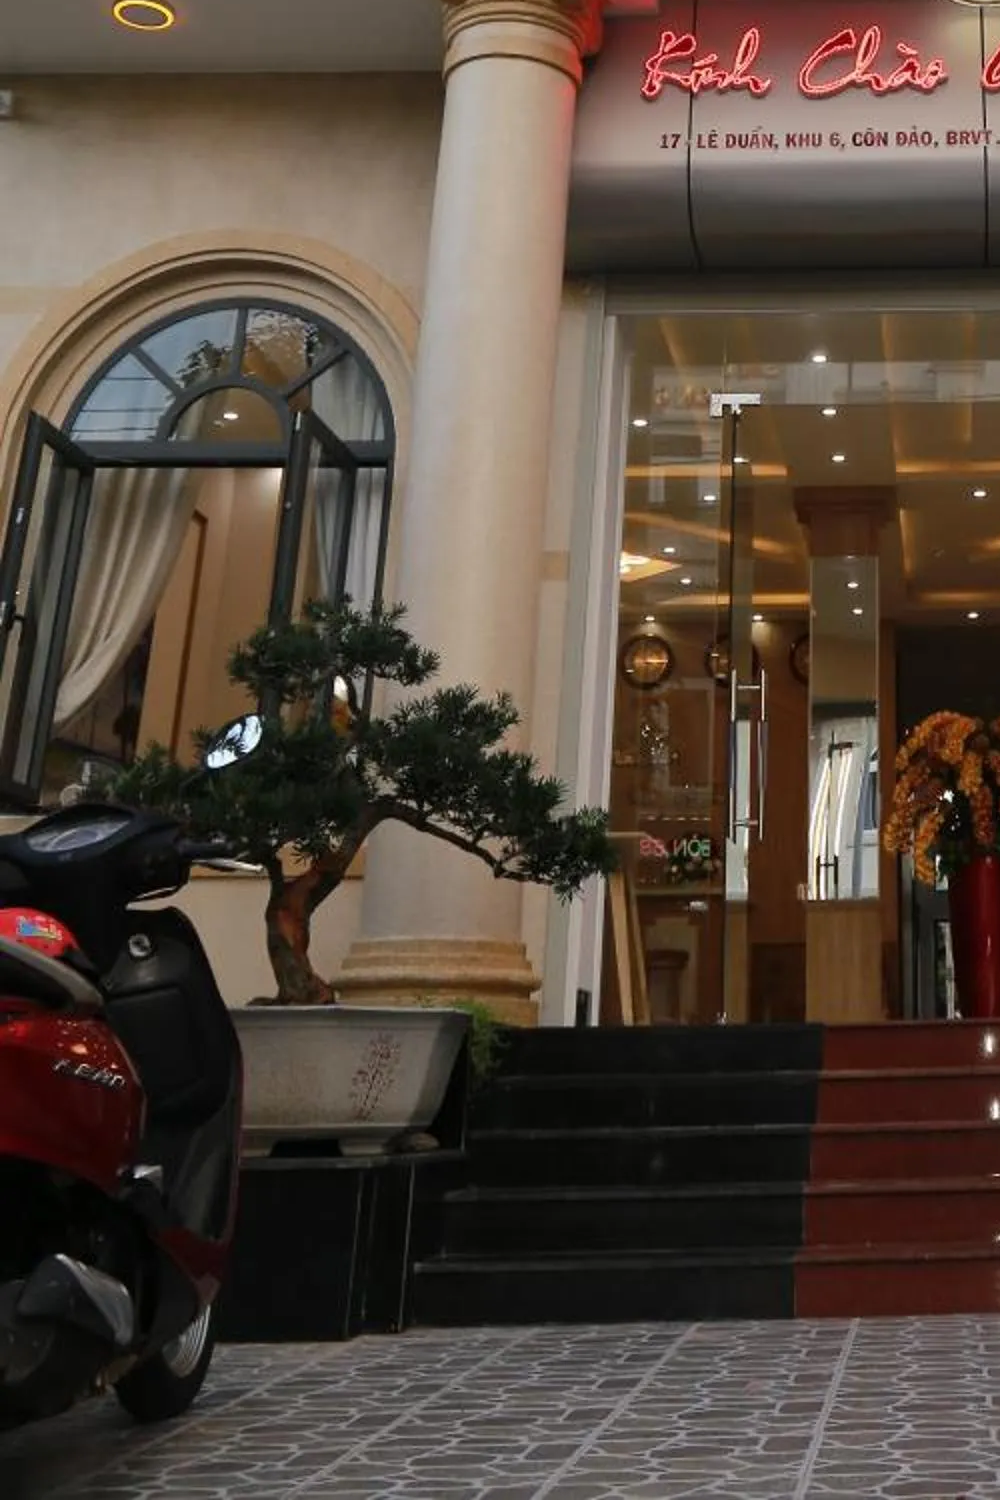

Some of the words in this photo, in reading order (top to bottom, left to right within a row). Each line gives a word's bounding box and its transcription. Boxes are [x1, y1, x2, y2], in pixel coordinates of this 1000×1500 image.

[641, 27, 771, 100] Kính
[799, 25, 949, 100] Chào
[659, 133, 682, 149] 17
[697, 129, 718, 149] LÊ
[785, 132, 823, 149] KHU
[829, 132, 845, 149] 6,
[851, 127, 889, 147] CÔN
